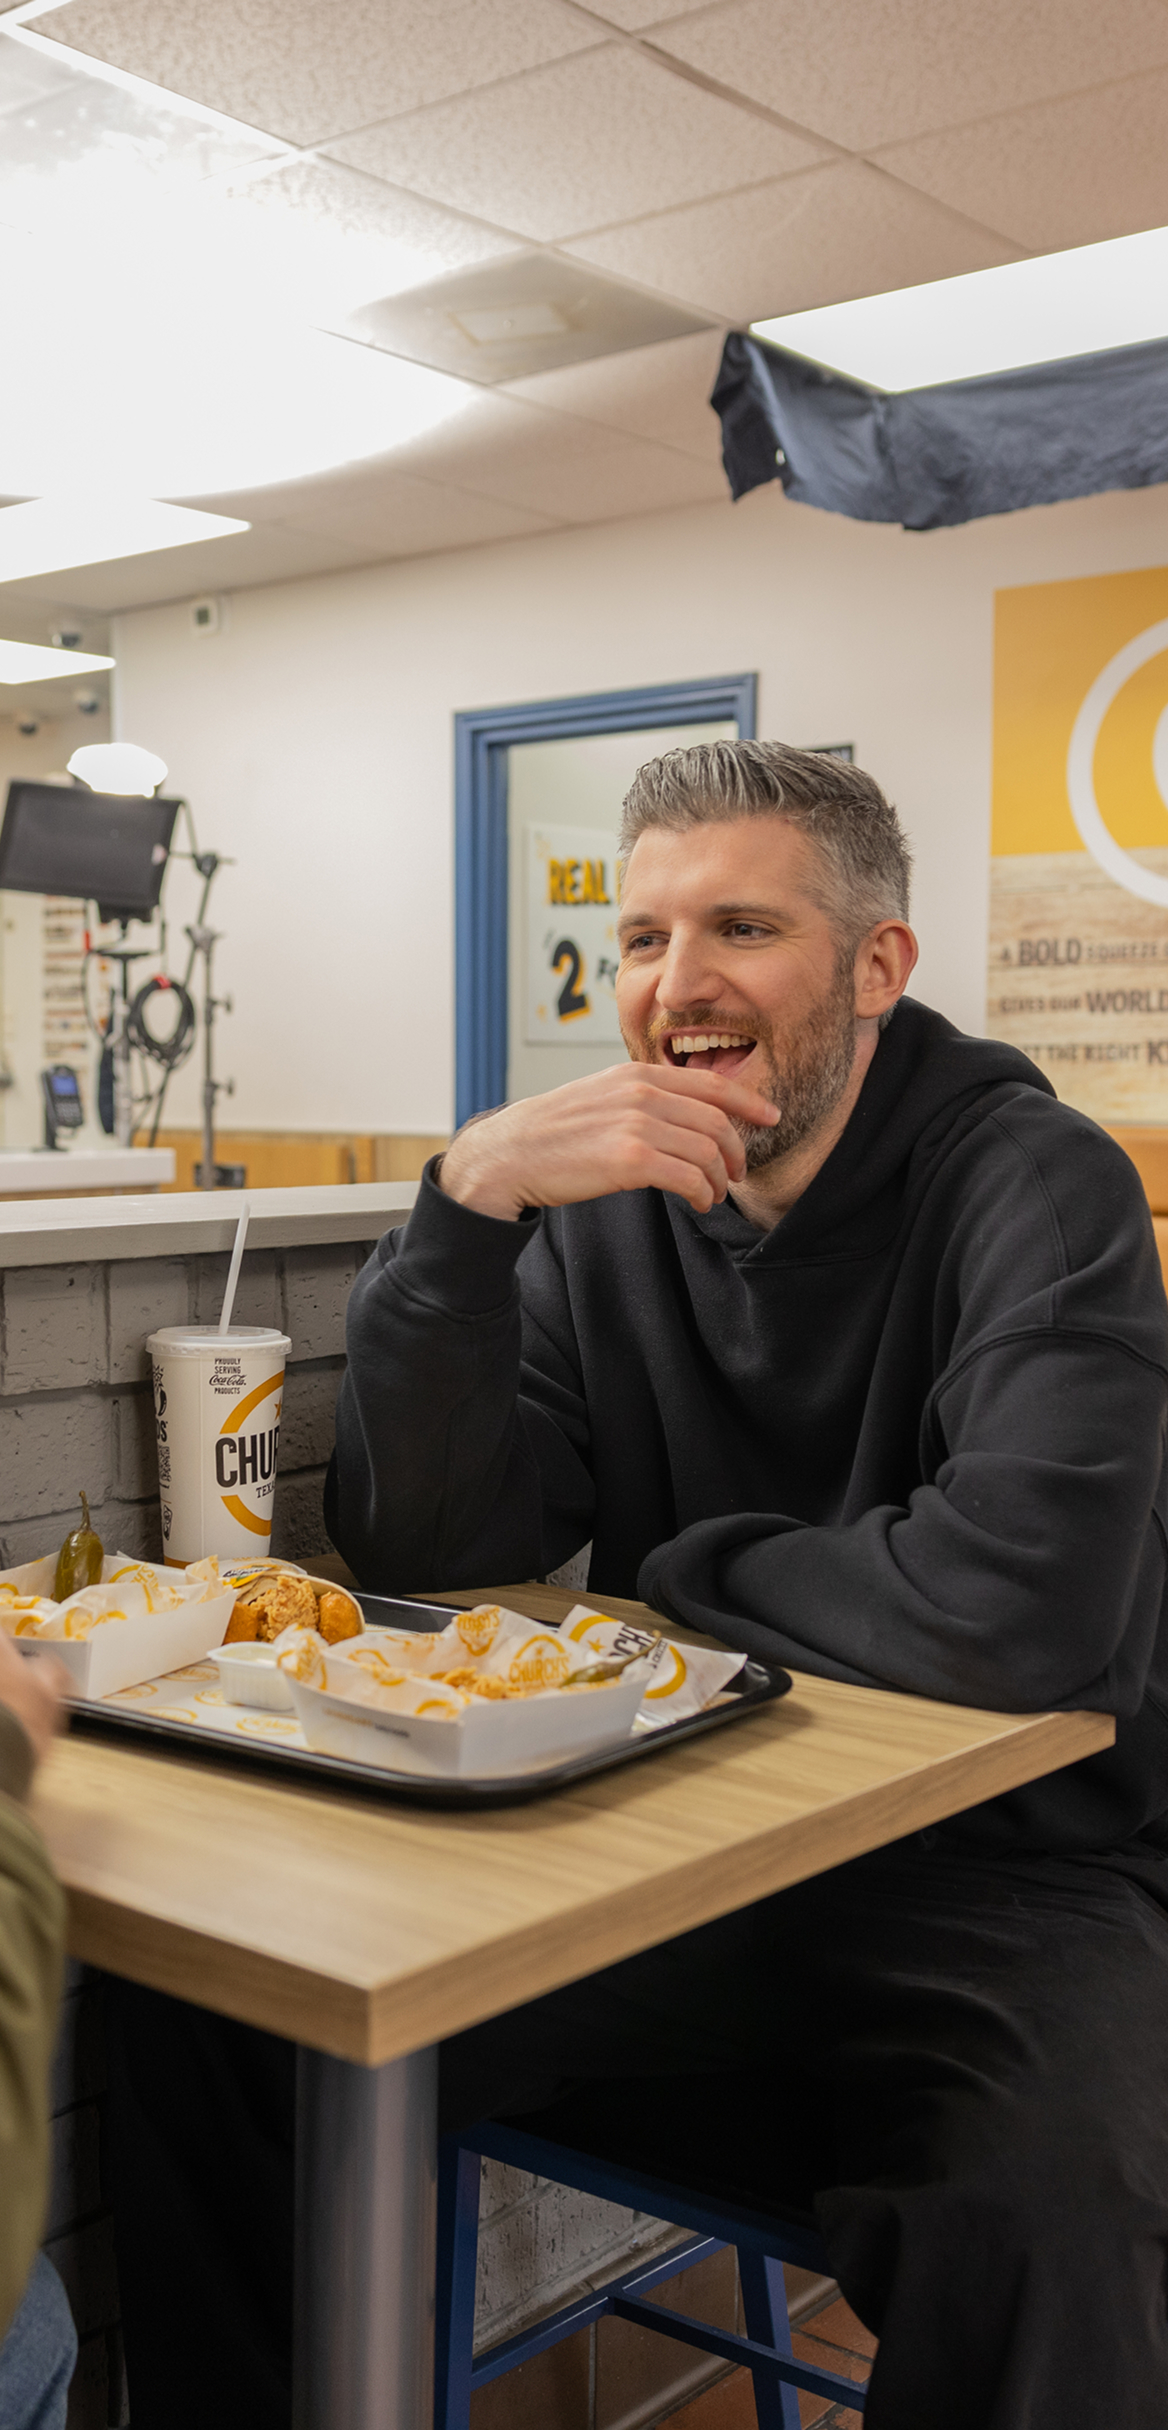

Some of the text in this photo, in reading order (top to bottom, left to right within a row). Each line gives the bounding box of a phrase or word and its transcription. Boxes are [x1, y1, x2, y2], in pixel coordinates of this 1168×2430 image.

[547, 858, 611, 905] REAL
[1019, 937, 1082, 966] BOLD
[551, 939, 592, 1023] 2
[1047, 1043, 1077, 1061] THE
[1084, 1042, 1141, 1062] RIGHT
[214, 1357, 241, 1365] PROUDLY
[214, 1365, 241, 1374] SERVING
[214, 1387, 241, 1395] PRODUCTS
[509, 1656, 570, 1685] CHURCH'S
